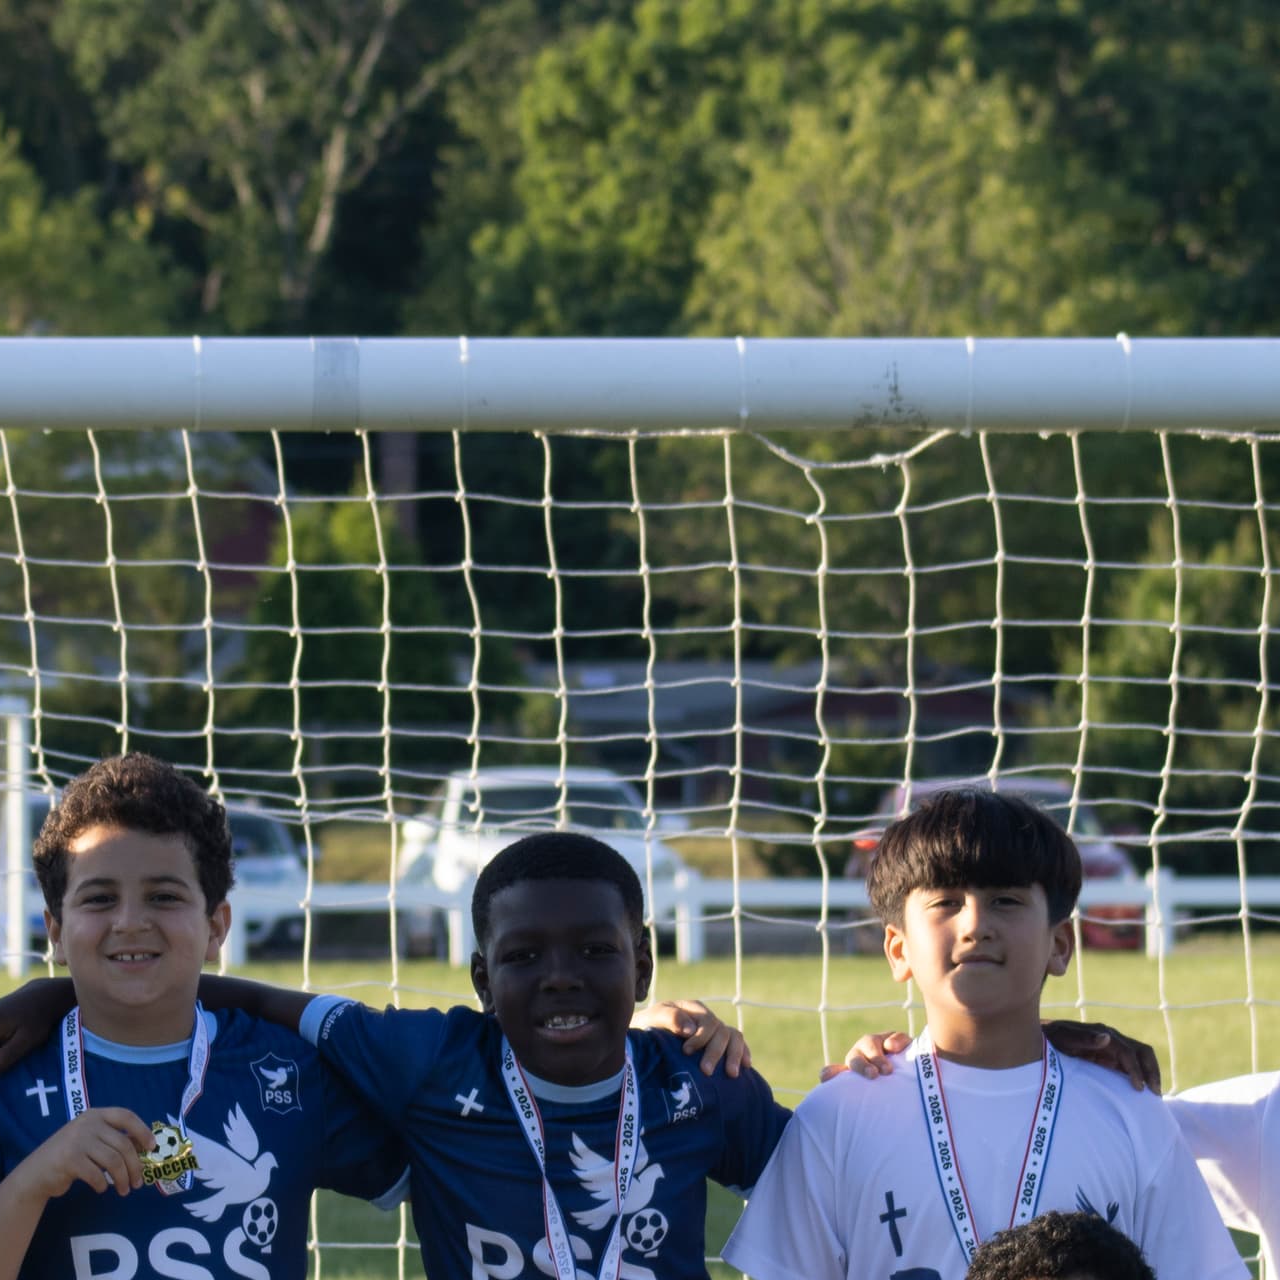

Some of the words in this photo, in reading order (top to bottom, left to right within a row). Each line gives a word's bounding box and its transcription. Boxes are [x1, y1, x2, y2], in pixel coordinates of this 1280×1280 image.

[67, 1049, 78, 1074] 2026
[265, 1091, 293, 1104] PSS
[514, 1088, 534, 1119] 2026
[673, 1106, 698, 1123] PSS
[623, 1113, 635, 1147] 2026
[928, 1095, 943, 1124] 2026
[938, 1141, 953, 1170] 2026
[949, 1188, 967, 1221] 2026
[1022, 1173, 1037, 1206] 2026
[1033, 1127, 1047, 1156] 2026
[1043, 1084, 1057, 1112] 2026
[143, 1156, 199, 1183] SOCCER
